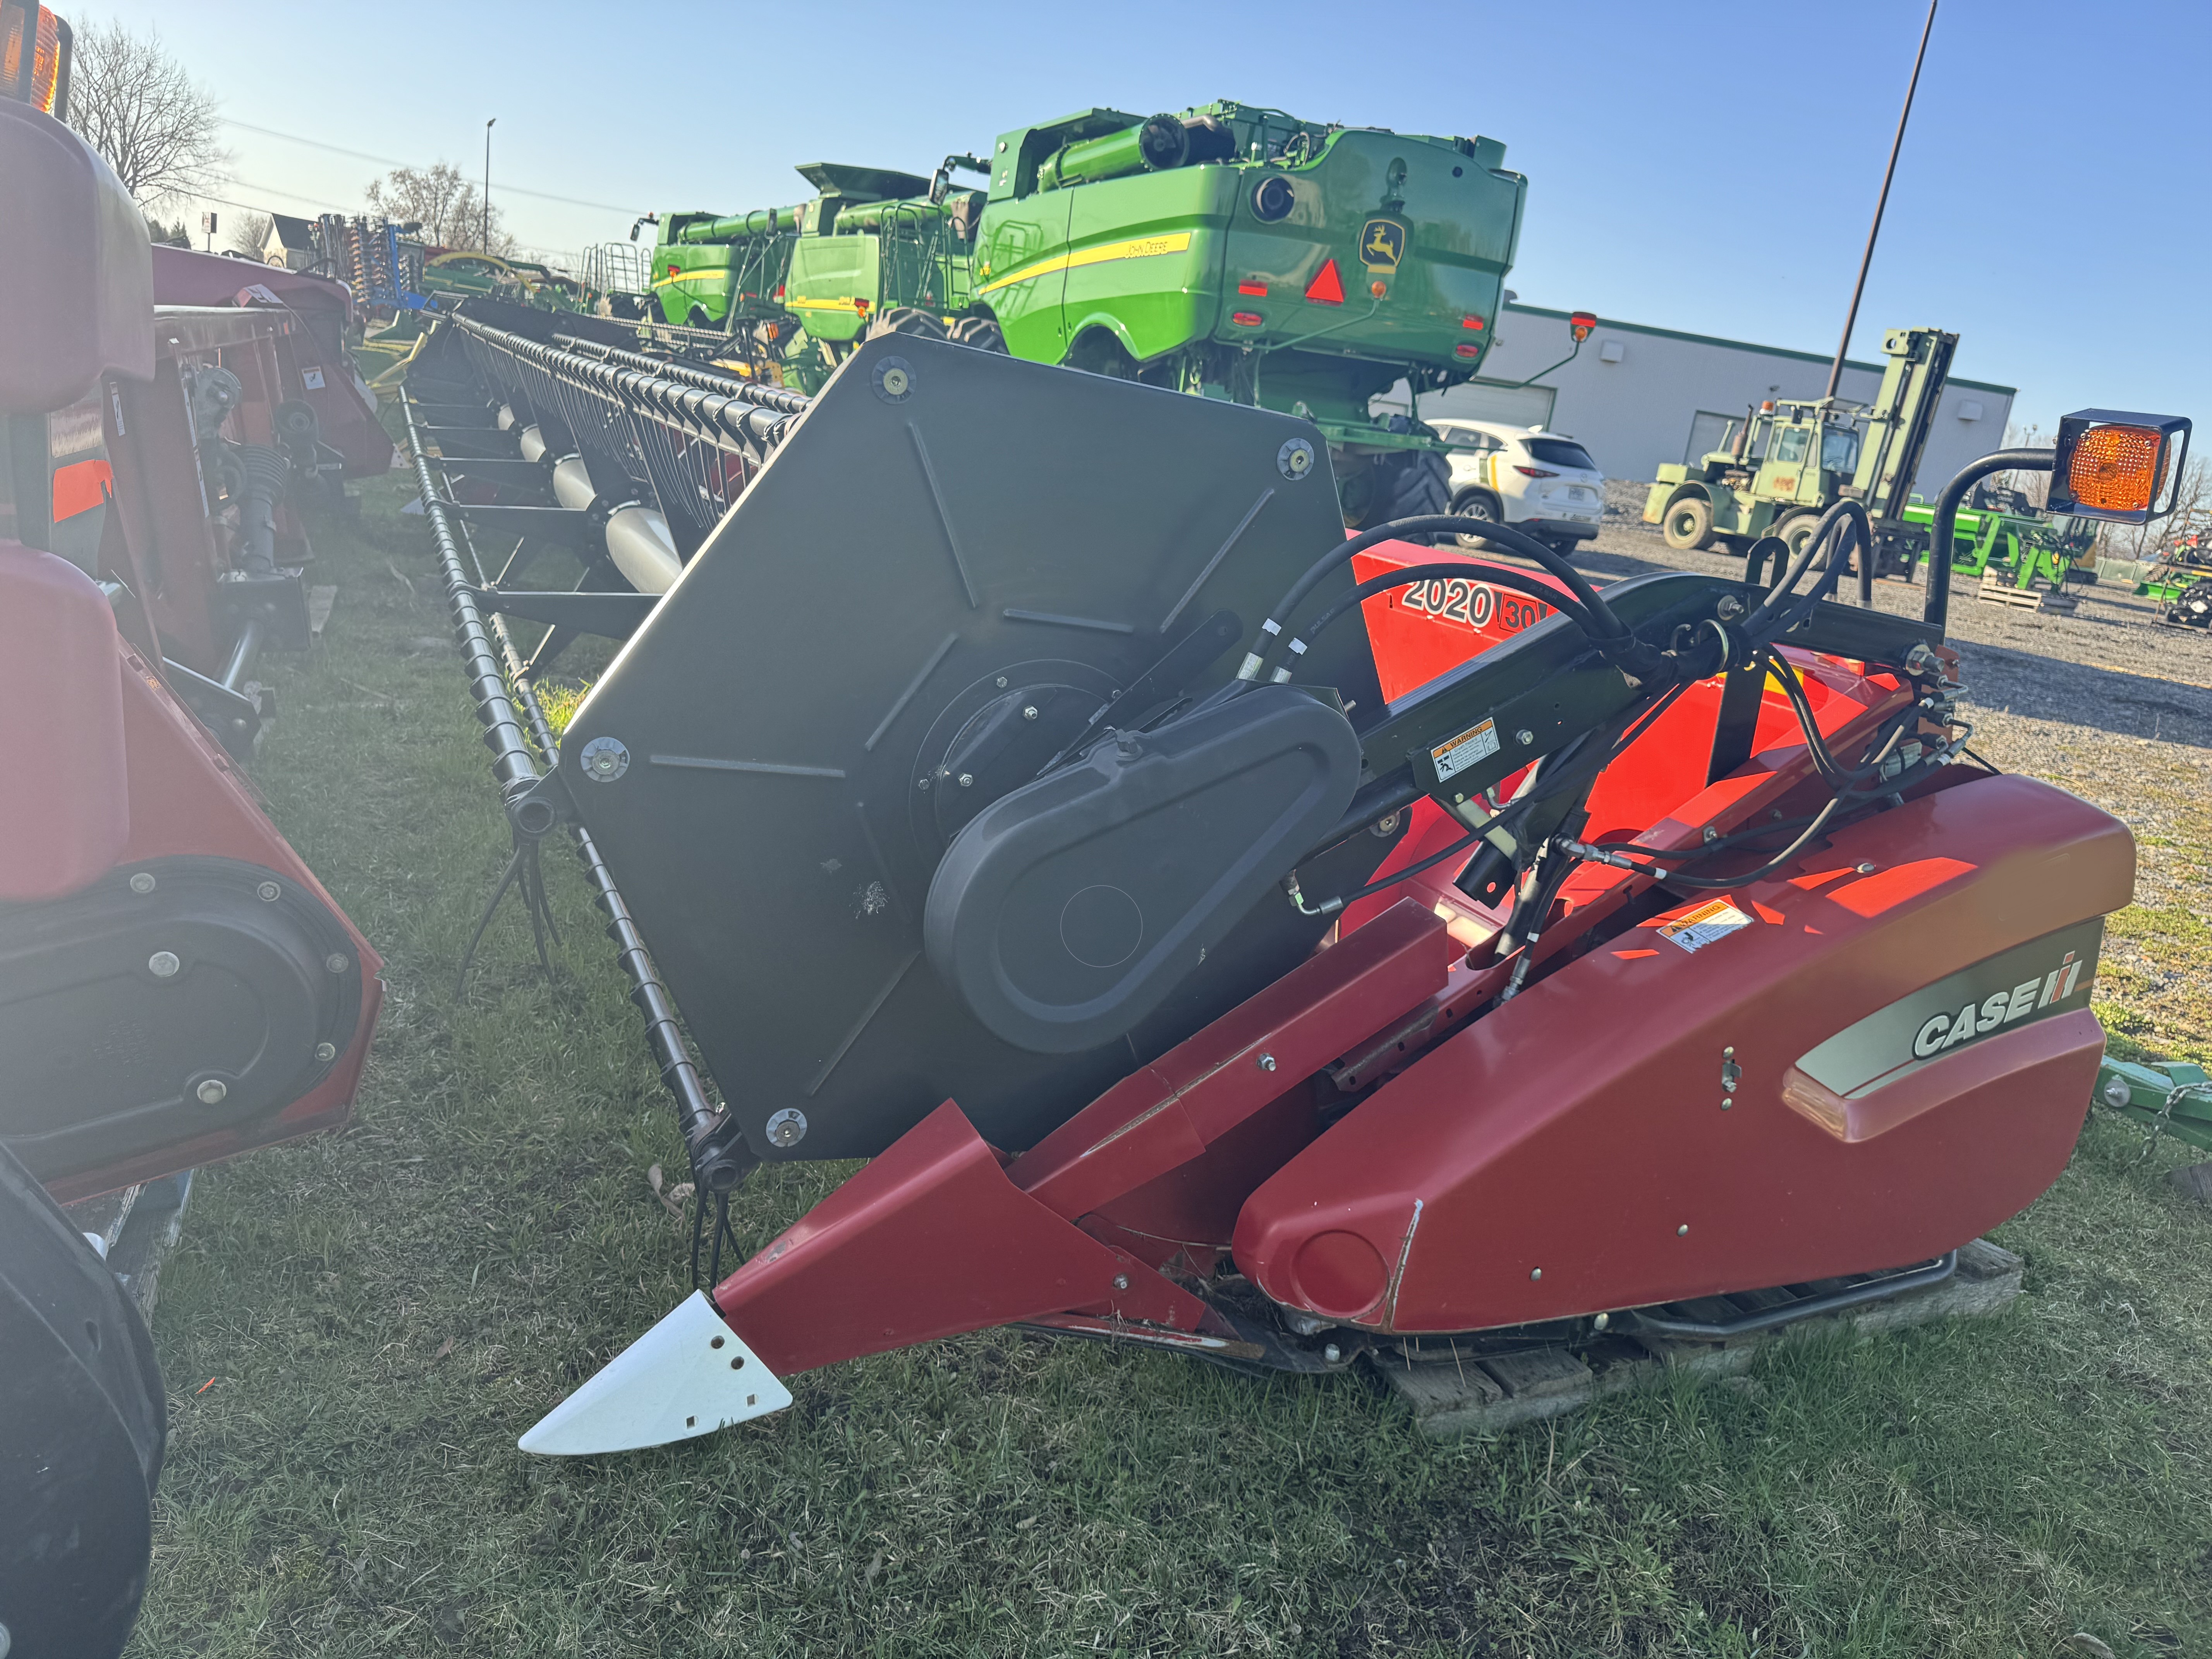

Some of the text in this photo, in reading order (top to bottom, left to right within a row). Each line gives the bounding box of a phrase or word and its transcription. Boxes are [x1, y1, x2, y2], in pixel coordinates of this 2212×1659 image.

[1402, 578, 1536, 629] 2020 30
[1450, 726, 1482, 748] WARNING
[1678, 905, 1721, 926] WARNING
[1914, 977, 2041, 1057] CASE
